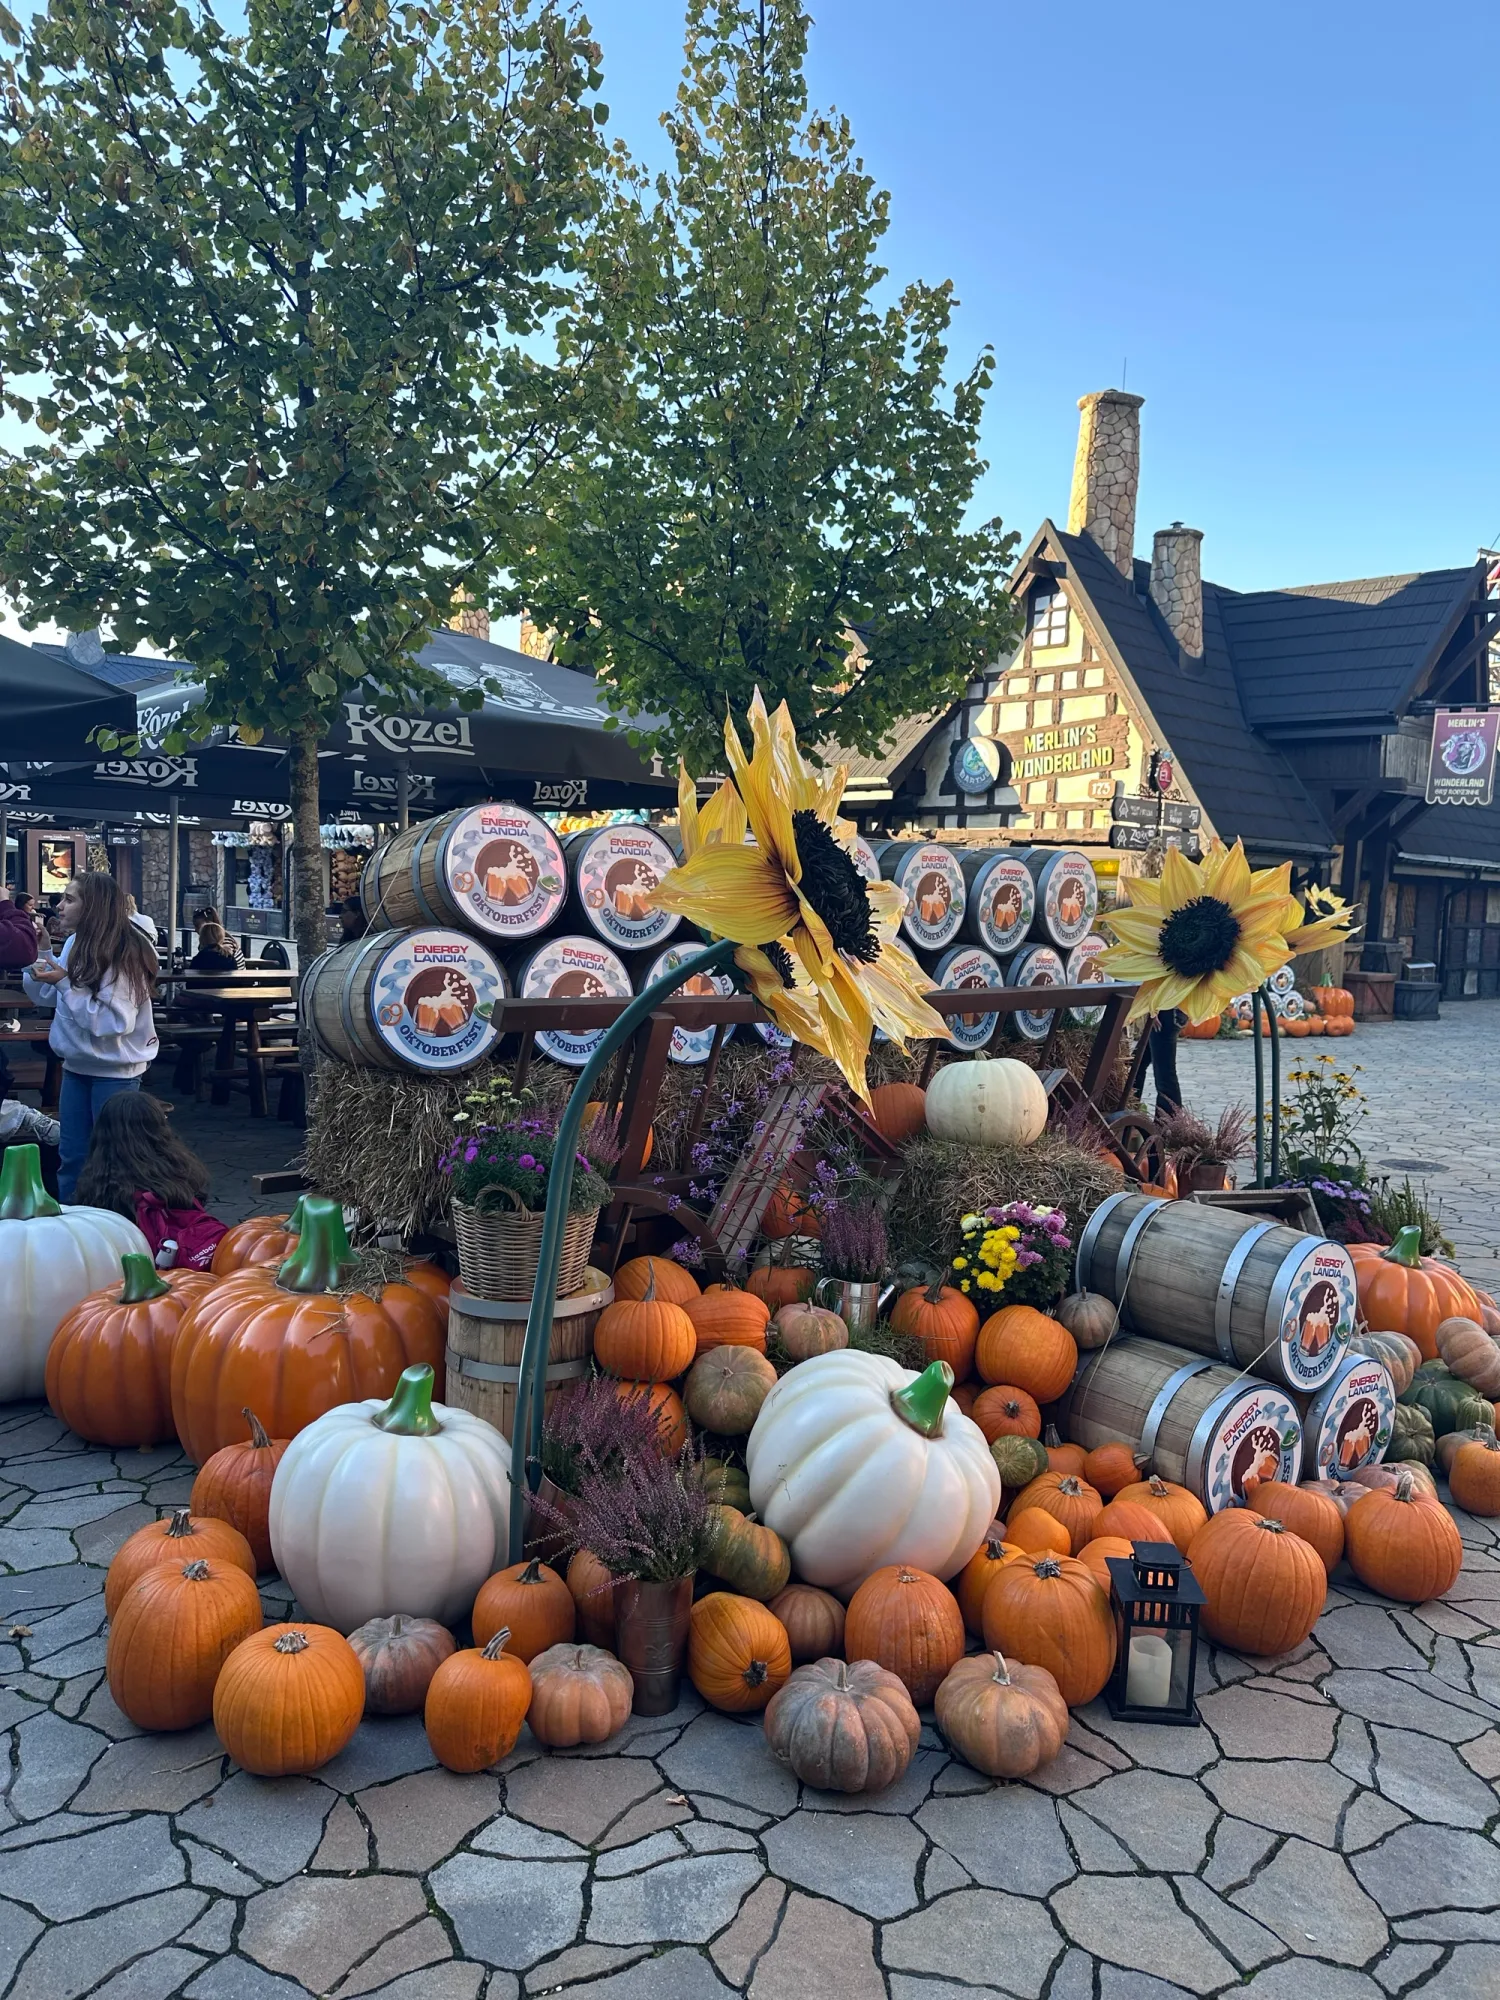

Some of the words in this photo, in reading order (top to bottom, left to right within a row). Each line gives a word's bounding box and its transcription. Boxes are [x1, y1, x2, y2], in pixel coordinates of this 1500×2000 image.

[343, 702, 475, 756] Kozel
[1448, 719, 1486, 728] MERLIN'S
[1024, 724, 1097, 754] MERLIN'S
[1011, 746, 1113, 779] WONDERLAND
[1091, 782, 1111, 796] 175
[1434, 778, 1485, 788] WONDERLAND
[481, 817, 531, 828] ENERGY
[481, 826, 529, 837] LANDIA
[610, 838, 654, 849] ENERGY
[610, 846, 652, 857] LANDIA
[921, 855, 950, 863] ENERGY
[921, 862, 948, 870] LANDIA
[1063, 862, 1086, 870] ENERGY
[1000, 868, 1025, 876] ENERGY
[472, 892, 546, 925] OKTOBERFEST
[602, 907, 668, 939] OKTOBERFEST
[912, 914, 954, 941] OKTOBERFEST
[413, 945, 469, 954] ENERGY
[562, 948, 609, 964] ENERGY
[414, 954, 467, 963] LANDIA
[561, 956, 605, 972] LANDIA
[953, 955, 981, 975] ENERGY
[1035, 956, 1056, 964] ENERGY
[954, 962, 982, 981] LANDIA
[1035, 963, 1055, 971] LANDIA
[955, 1011, 994, 1043] OKTOBERFES
[400, 1021, 482, 1057] OKTOBERFEST
[1314, 1256, 1346, 1269] ENERGY
[1312, 1267, 1342, 1278] LANDIA
[1290, 1341, 1337, 1378] OKTOBERFEST
[1349, 1372, 1383, 1389] ENERGY
[1348, 1383, 1379, 1398] LANDIA
[1222, 1397, 1260, 1444] ENERGY
[1225, 1408, 1263, 1451] LANDIA
